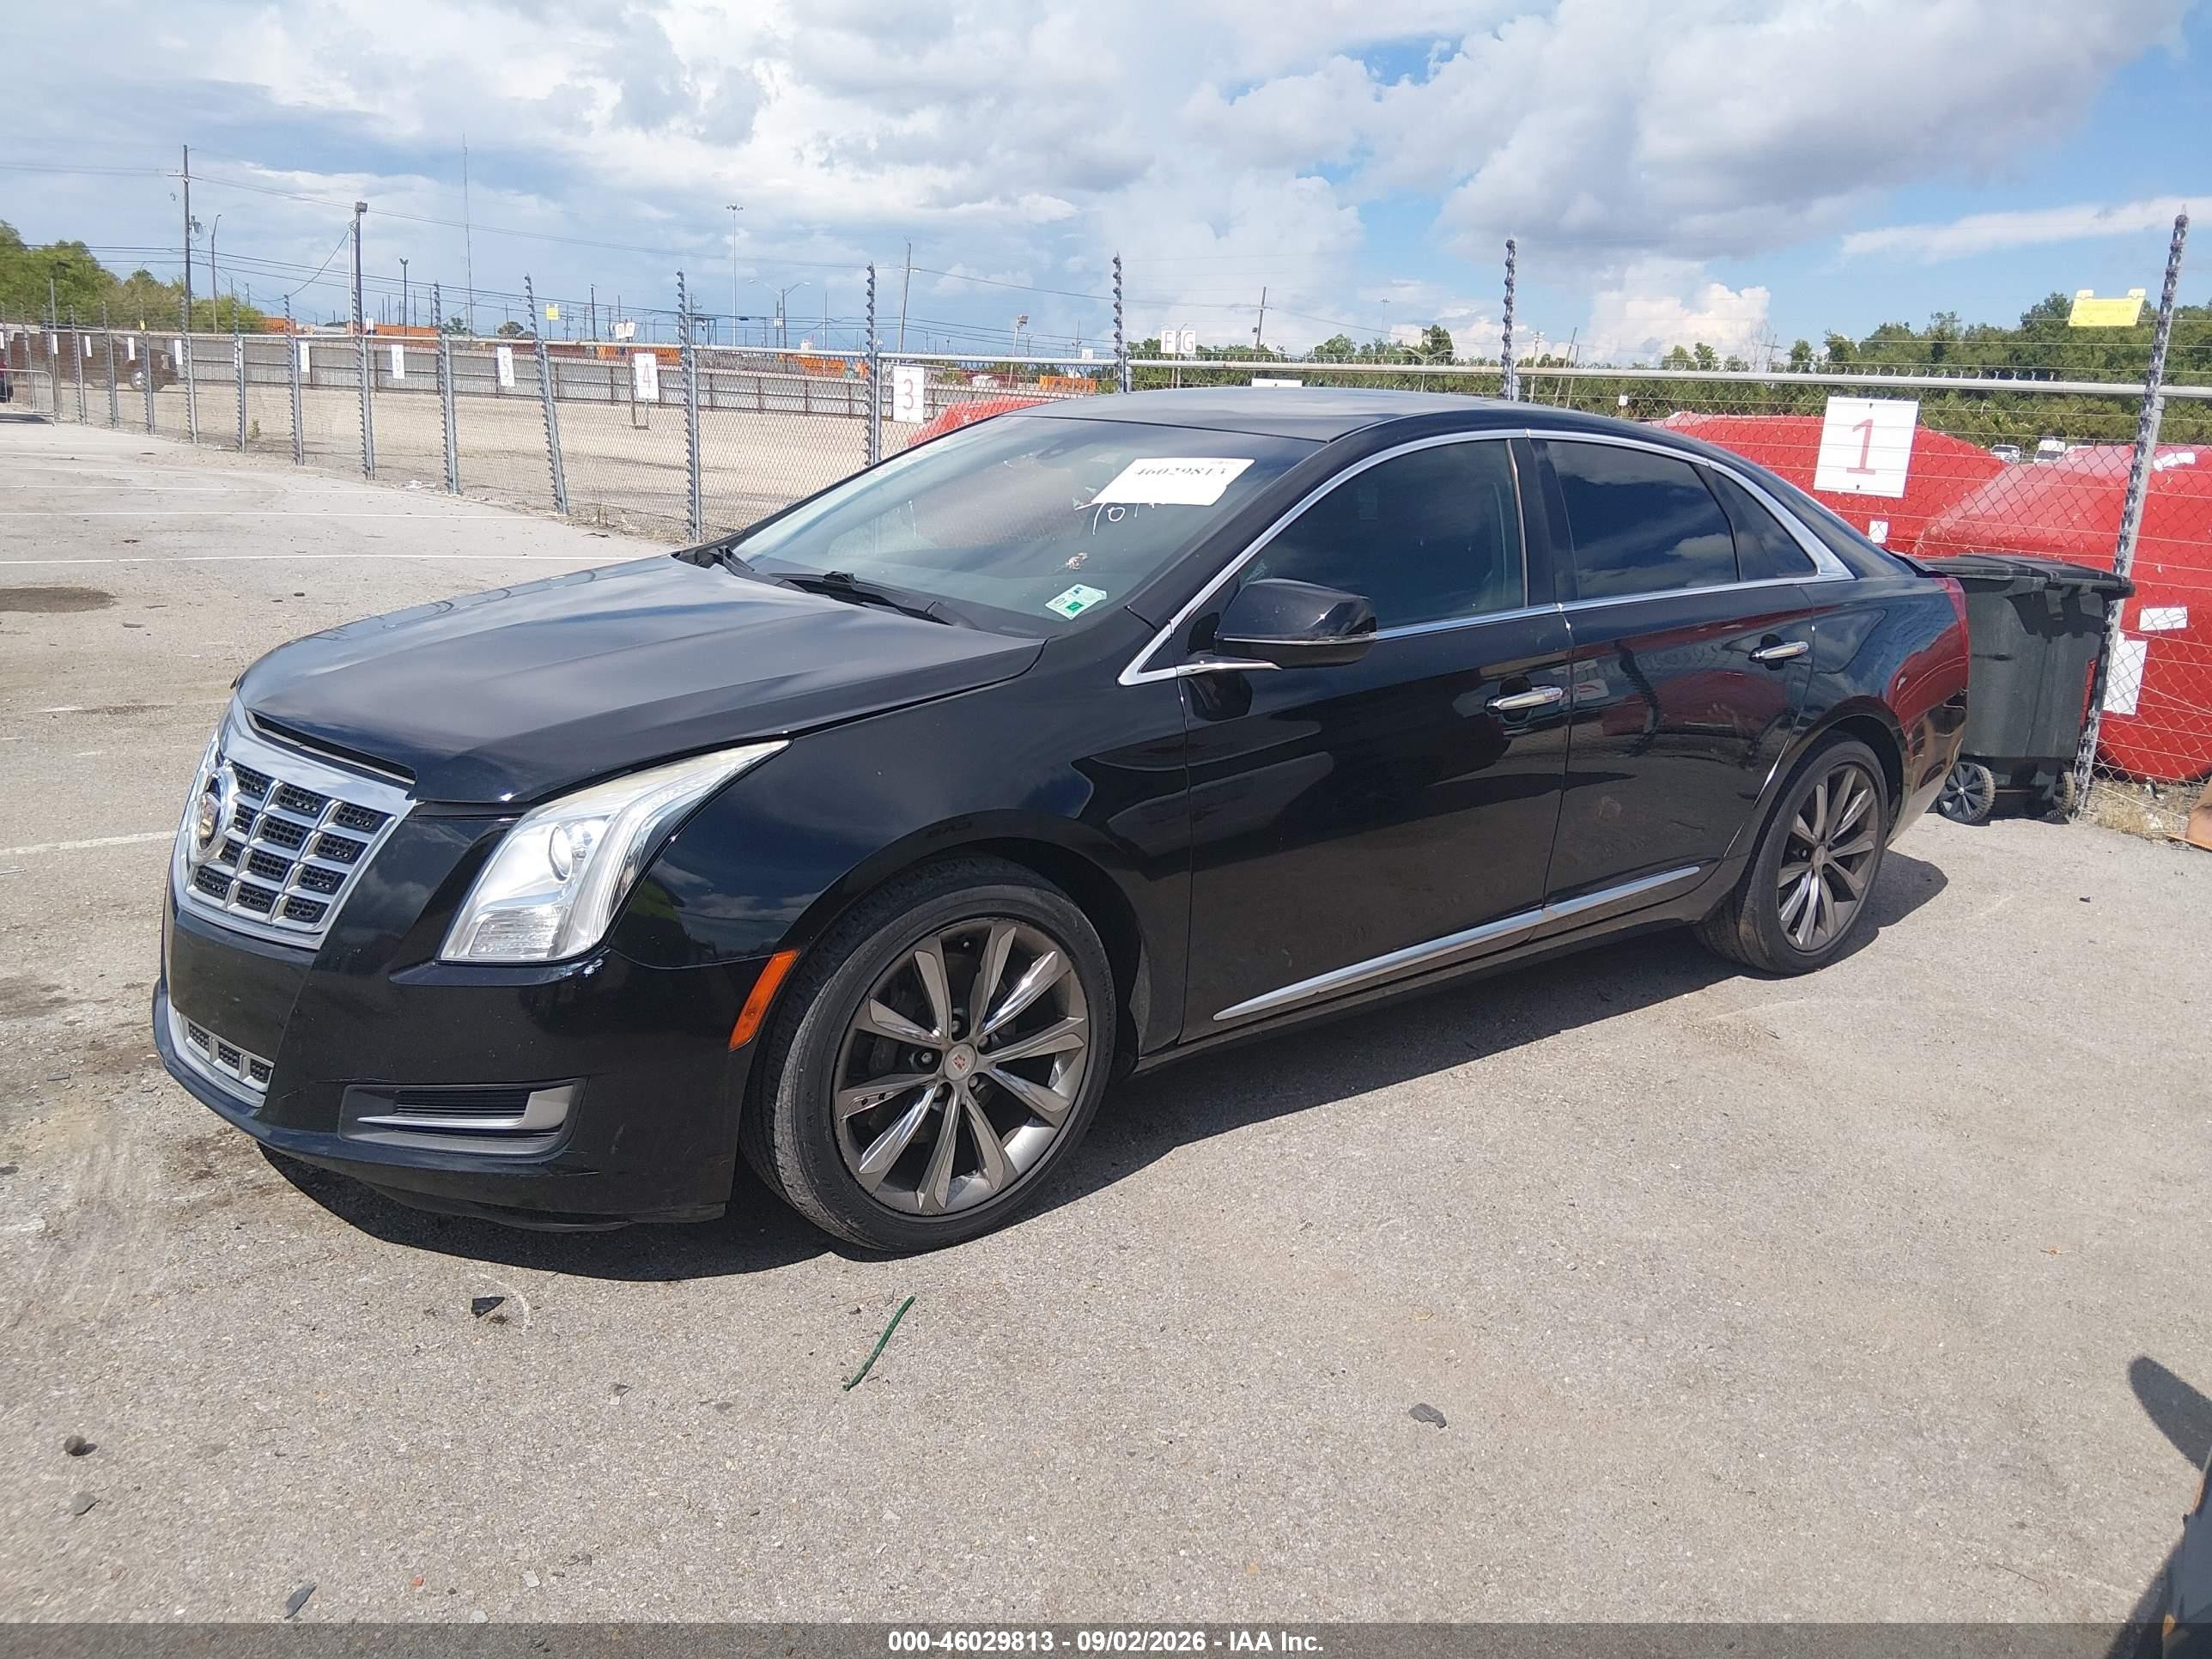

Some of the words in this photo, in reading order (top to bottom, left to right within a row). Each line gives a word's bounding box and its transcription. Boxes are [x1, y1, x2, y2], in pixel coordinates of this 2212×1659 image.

[1164, 331, 1173, 352] F
[1182, 331, 1194, 352] G
[501, 355, 510, 378] 5
[642, 362, 652, 389] 4
[902, 379, 915, 410] 3
[1846, 418, 1876, 476] 1
